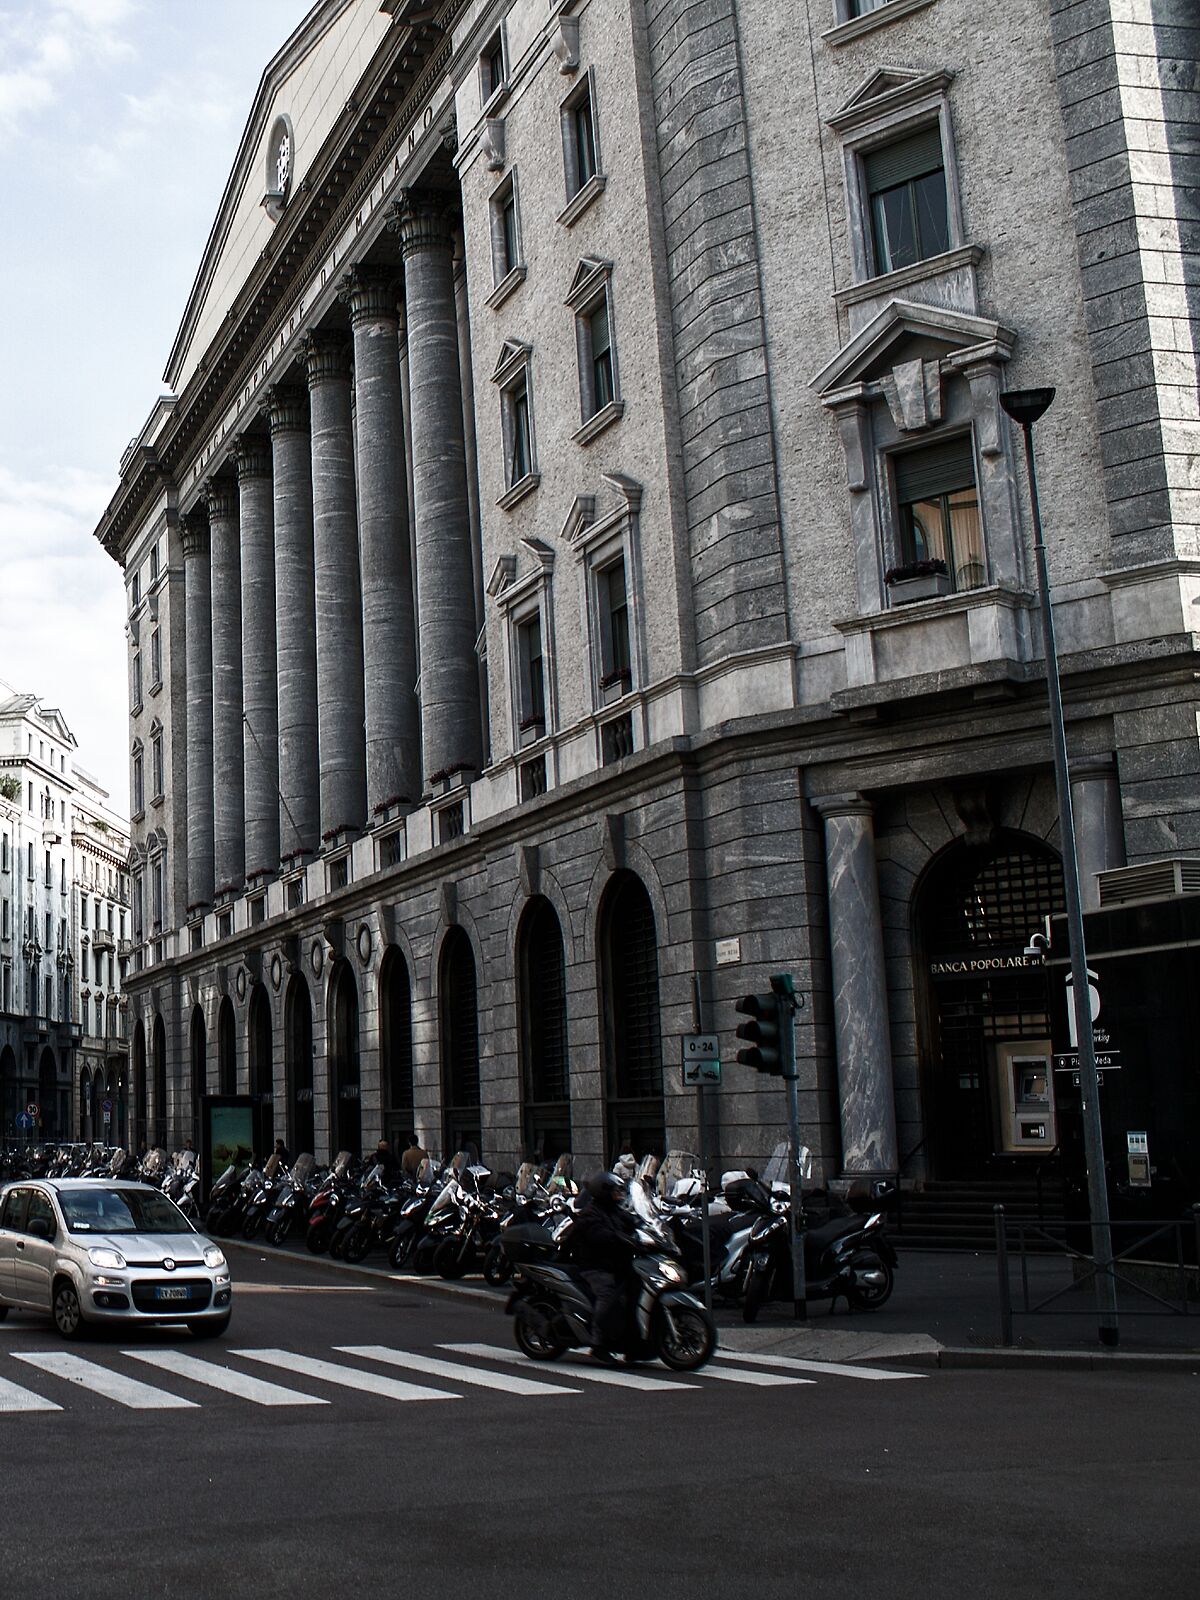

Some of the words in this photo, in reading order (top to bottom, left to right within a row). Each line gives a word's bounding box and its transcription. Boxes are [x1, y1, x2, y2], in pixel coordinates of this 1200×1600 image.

[237, 300, 304, 414] POPOLARE
[320, 252, 336, 287] DI
[355, 106, 433, 233] MILANO
[930, 961, 968, 974] BANCA
[970, 956, 1029, 971] POPOLARE
